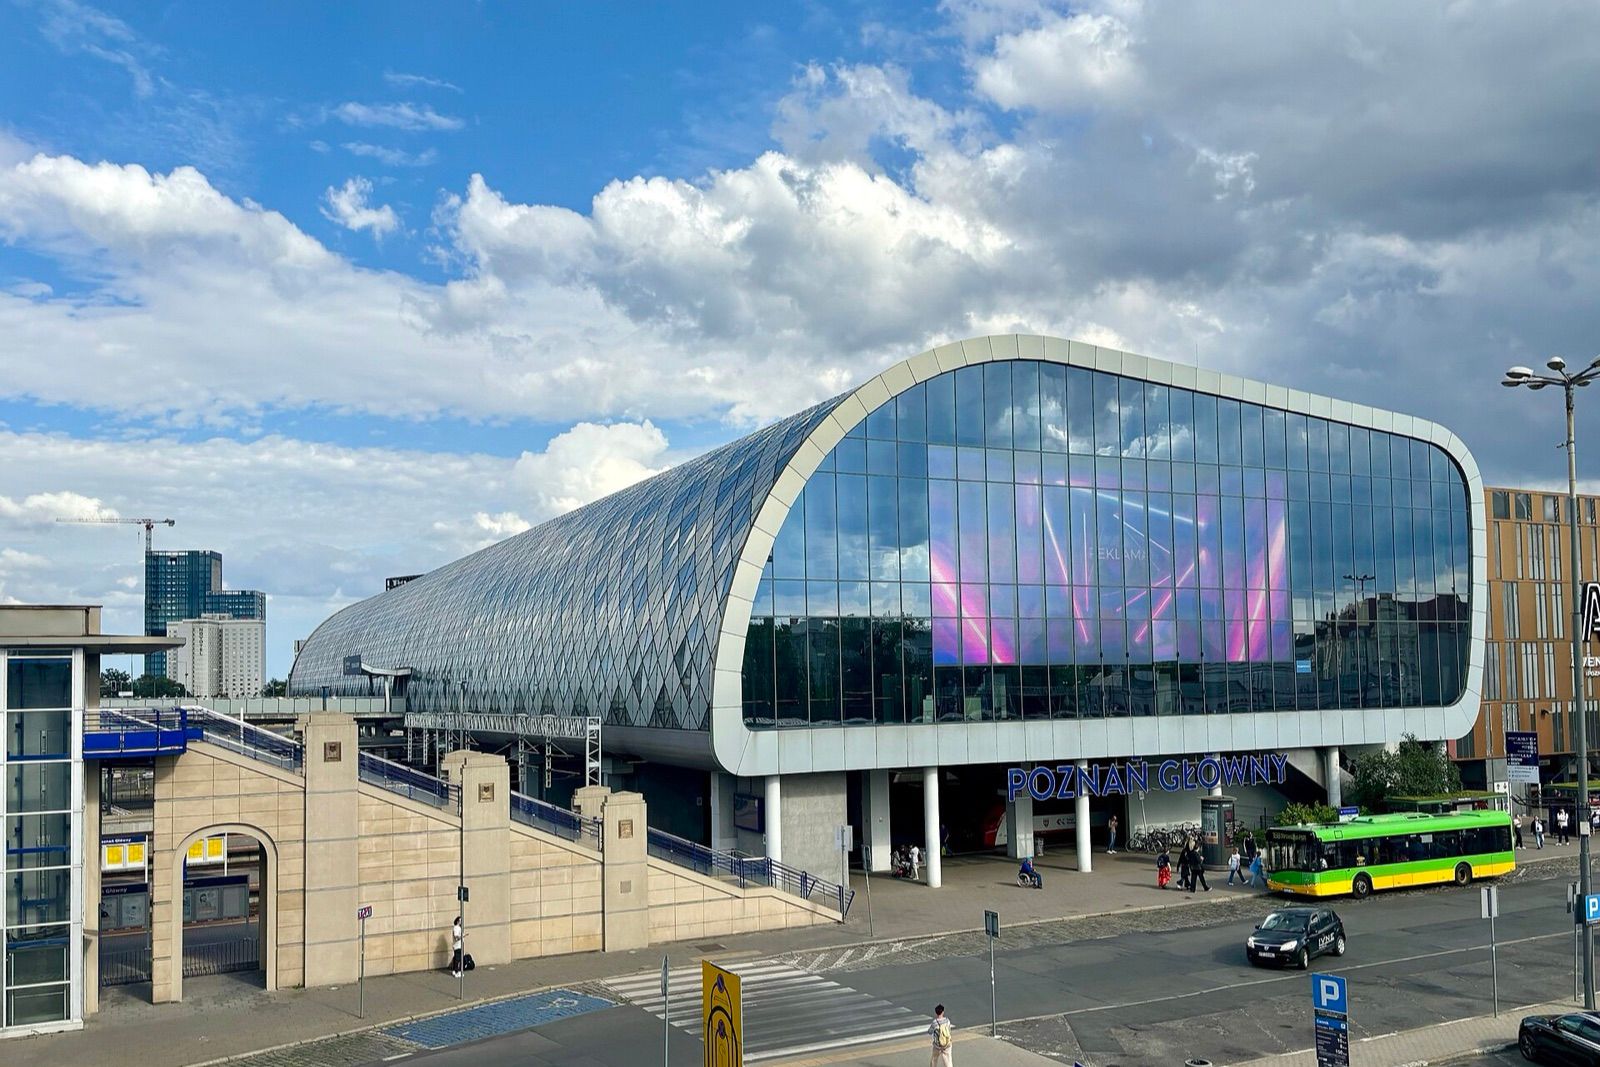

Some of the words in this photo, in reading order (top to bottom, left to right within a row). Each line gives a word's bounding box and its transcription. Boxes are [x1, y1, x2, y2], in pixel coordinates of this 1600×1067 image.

[1007, 756, 1149, 802] POZNAŃ
[1158, 752, 1289, 793] GŁÓWNY
[1589, 897, 1599, 918] P
[1320, 979, 1340, 1006] P
